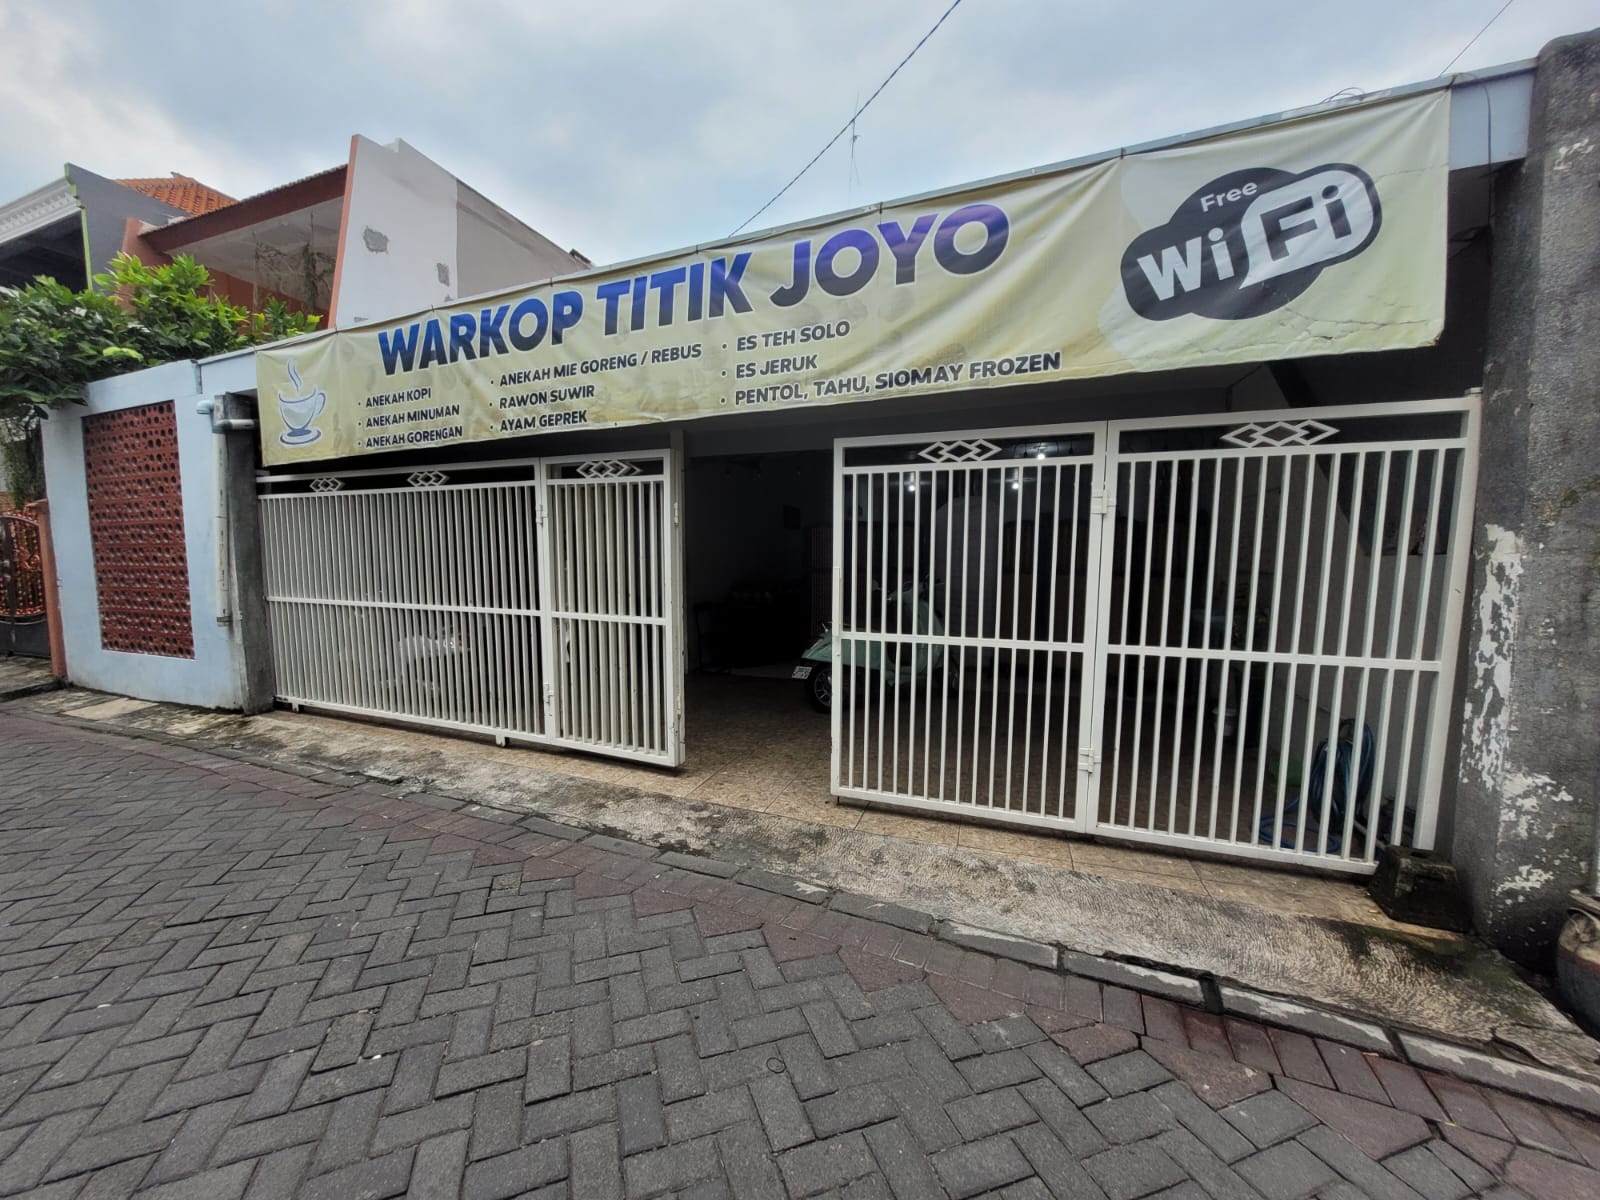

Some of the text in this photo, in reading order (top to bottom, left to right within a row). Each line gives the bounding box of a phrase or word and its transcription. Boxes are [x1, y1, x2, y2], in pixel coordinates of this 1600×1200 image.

[1201, 182, 1258, 212] Free
[378, 203, 1010, 376] WARKOP TITIK JOYO
[737, 320, 850, 351] ES TEH SOLO
[500, 343, 702, 387] ANEKAH MIE GORENG / REBUS
[736, 354, 818, 378] ES JERUK
[735, 351, 1061, 405] PENTOL, TAHU, SIOMAY FROZEN
[365, 387, 431, 408] ANEKAH KOPI
[499, 385, 595, 409] RAWON SUWIR
[366, 404, 460, 428] ANEKAH MINUMAN
[500, 409, 588, 432] AYAM GEPREK
[366, 425, 463, 448] ANEKAH GORENGAN
